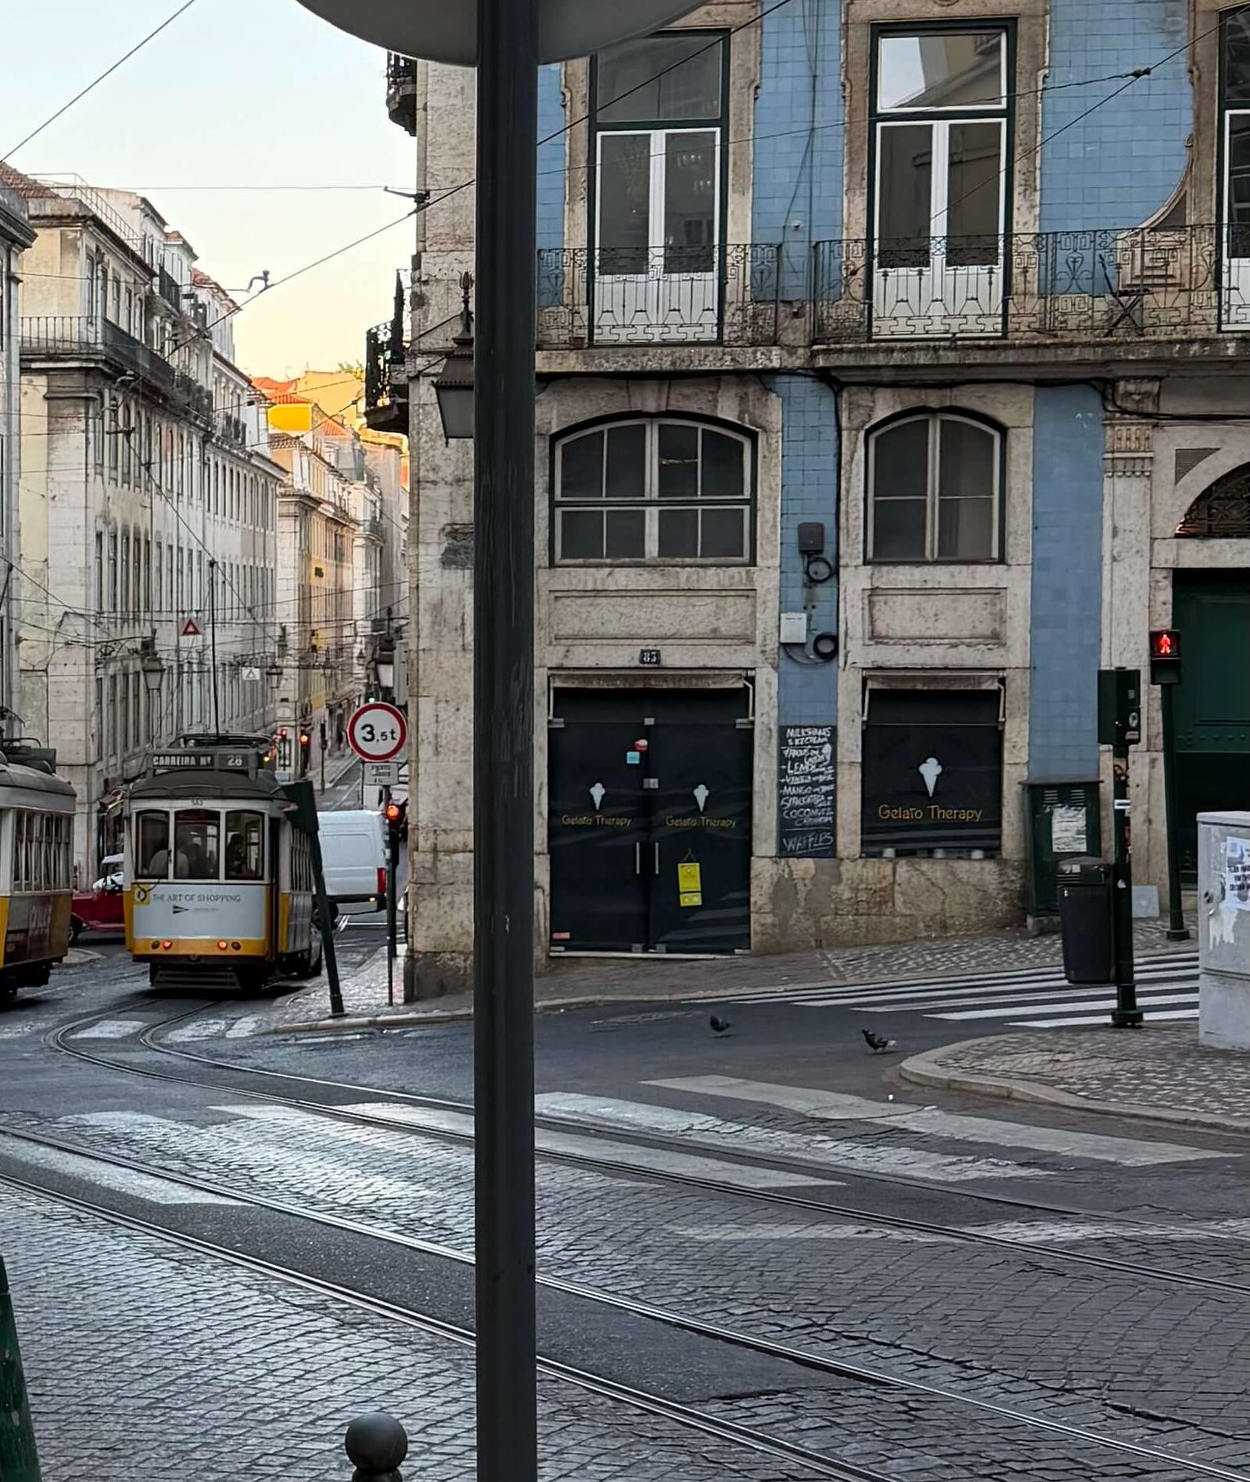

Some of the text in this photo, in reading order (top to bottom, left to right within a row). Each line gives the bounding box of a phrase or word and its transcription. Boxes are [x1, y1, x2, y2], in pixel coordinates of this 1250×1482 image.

[153, 755, 197, 766] CARREIRA
[226, 754, 243, 767] 28
[878, 803, 983, 823] Gelato Therapy
[152, 893, 242, 903] THE ART OF SHOPPING
